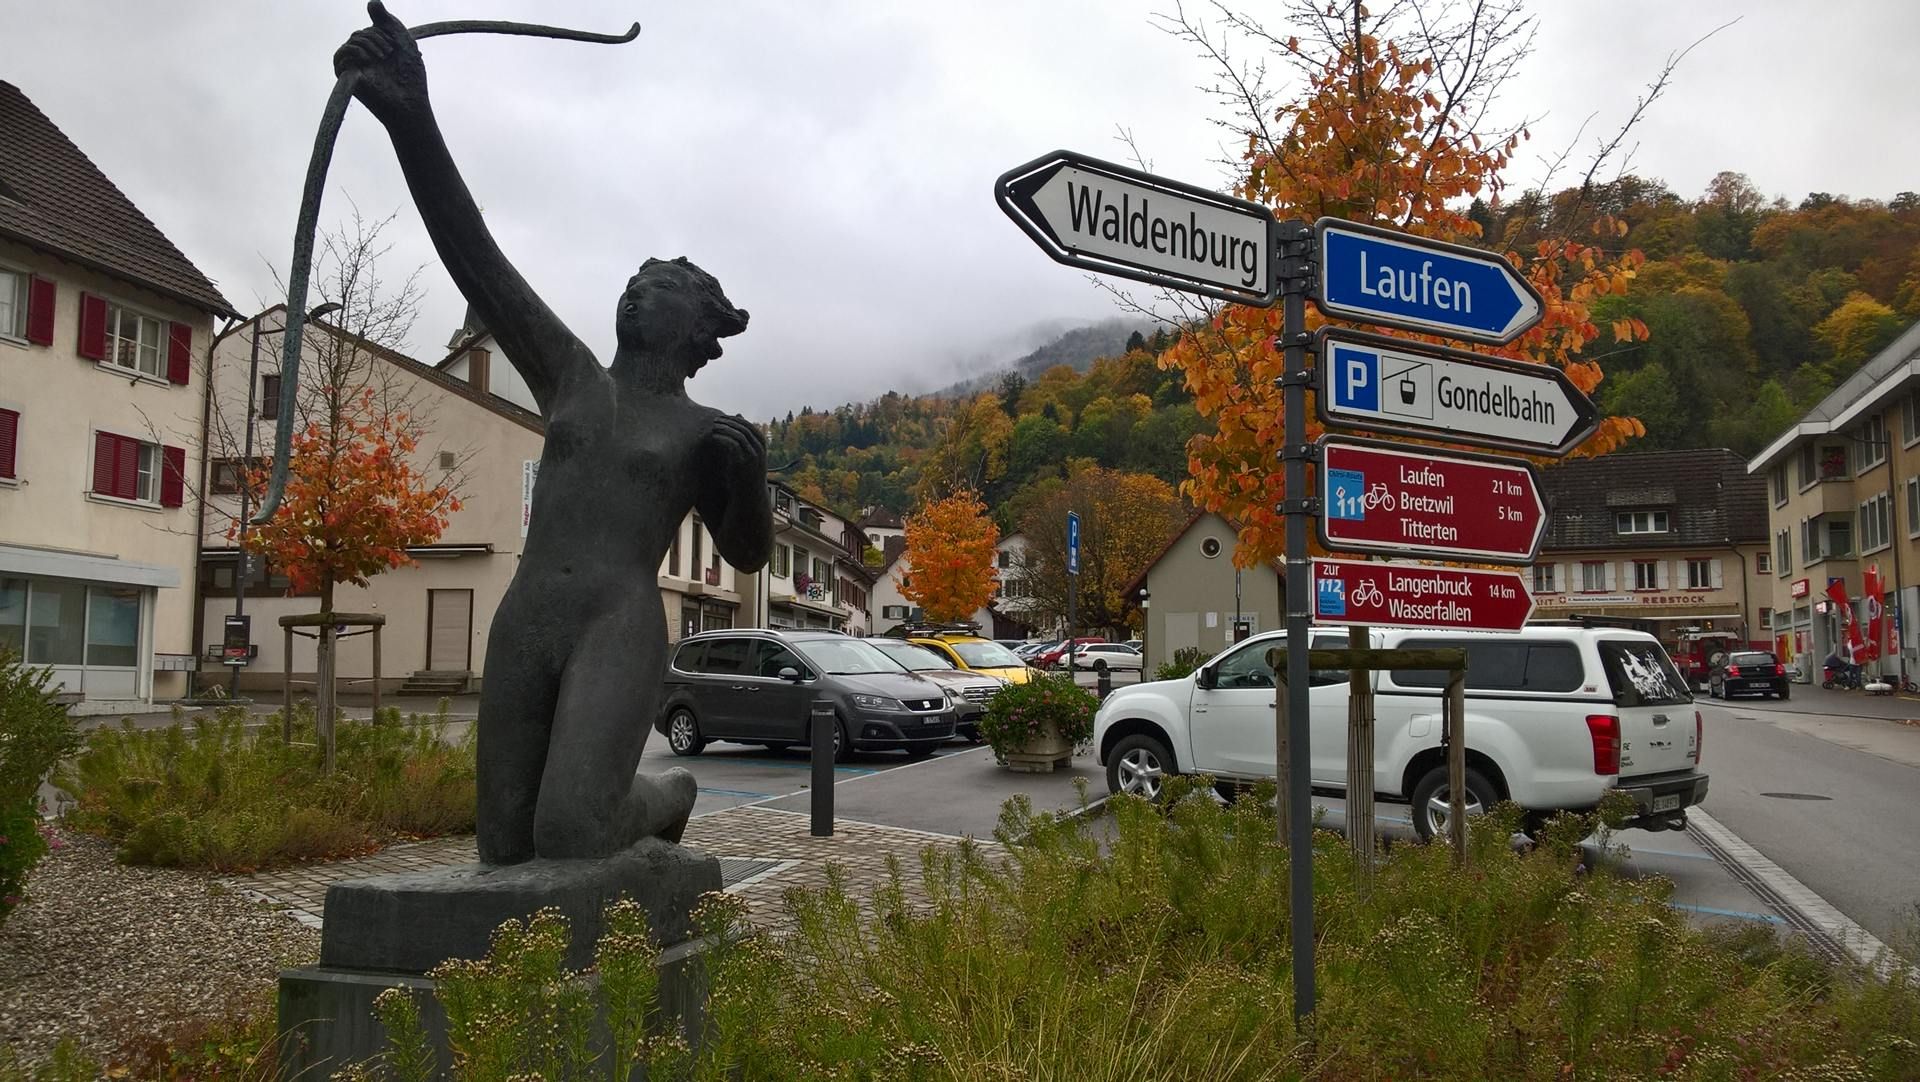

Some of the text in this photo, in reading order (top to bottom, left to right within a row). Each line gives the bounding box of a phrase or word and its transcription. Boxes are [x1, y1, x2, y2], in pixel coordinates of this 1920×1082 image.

[1067, 181, 1258, 288] Waldenburg
[1360, 250, 1472, 314] Laufen
[1346, 359, 1556, 426] P Gondelbahn
[1399, 464, 1523, 497] Laufen 21 km
[1336, 494, 1365, 518] 111
[1400, 491, 1523, 522] Bretzwil 5 km
[1400, 517, 1458, 541] Titterten
[1322, 564, 1340, 576] zur
[1318, 578, 1342, 593] 112
[1388, 571, 1516, 599] Langenbruck 14 km
[1388, 598, 1472, 622] Wasserfallen
[1642, 595, 1705, 605] REBSTOCK
